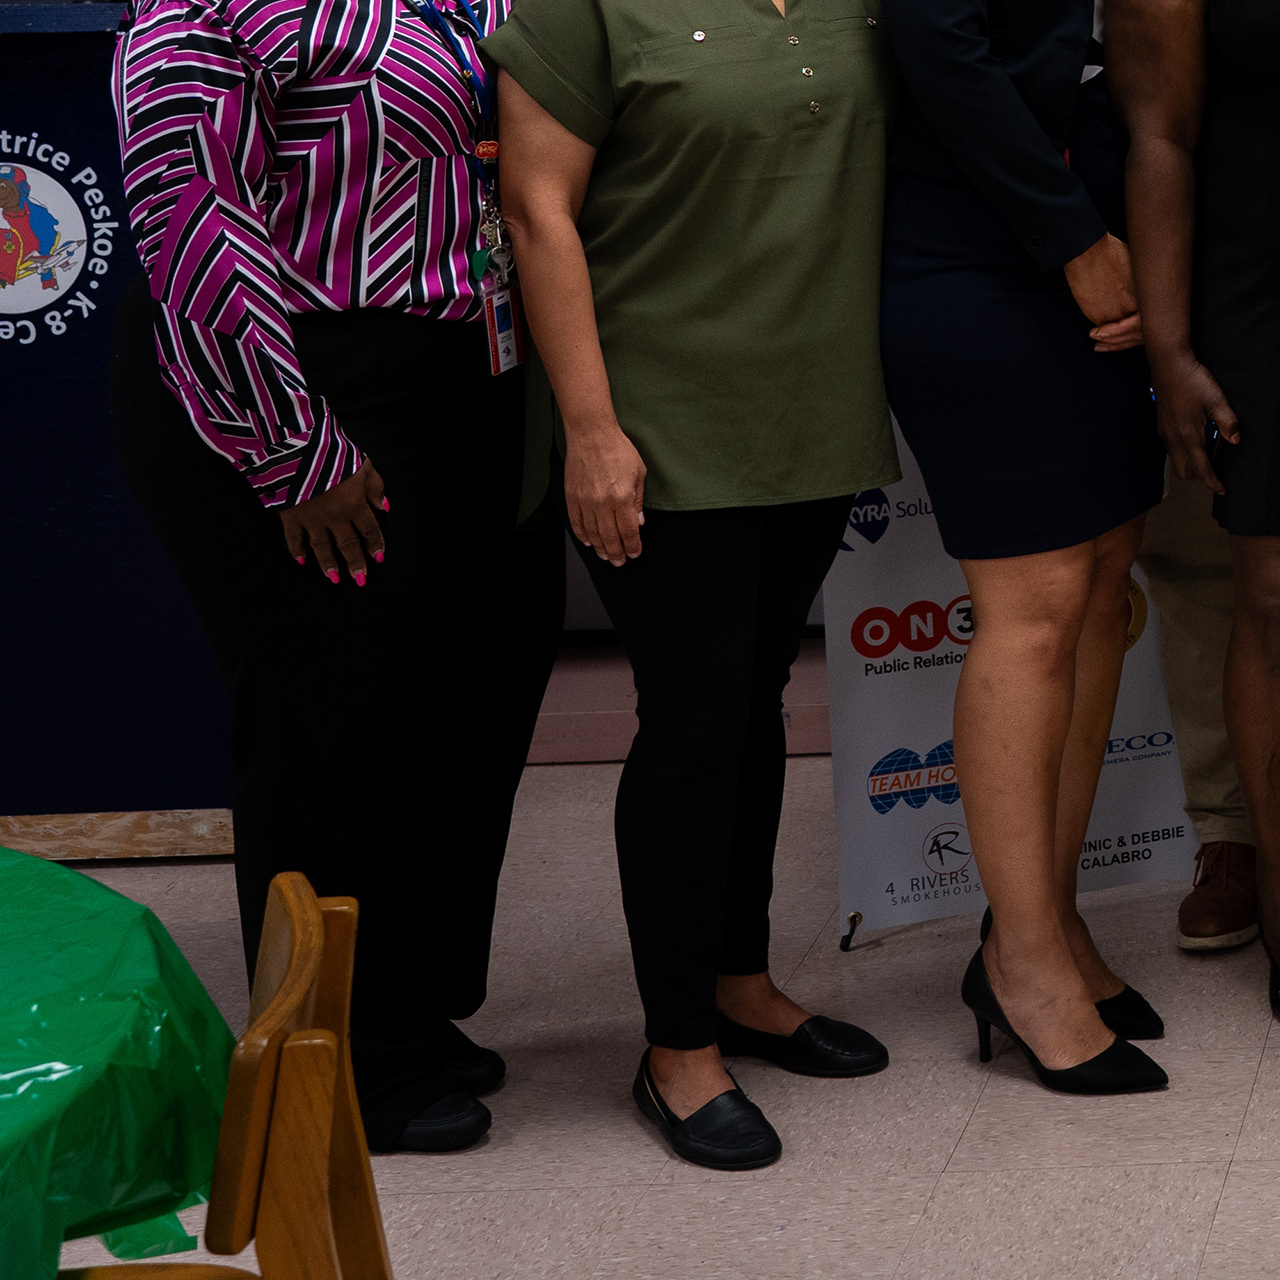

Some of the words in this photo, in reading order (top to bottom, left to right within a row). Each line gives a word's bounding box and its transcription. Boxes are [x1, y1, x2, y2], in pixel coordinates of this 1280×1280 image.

[70, 166, 120, 276] Peskoe
[44, 290, 97, 336] K-8
[864, 658, 910, 677] Public
[1132, 750, 1172, 761] COMPANY
[870, 770, 921, 794] TEAM
[927, 766, 957, 785] HO
[1117, 836, 1127, 848] &
[1131, 825, 1185, 845] DEBBIE
[1081, 848, 1152, 870] CALABRO
[885, 882, 895, 895] 4
[910, 869, 970, 892] RIVERS
